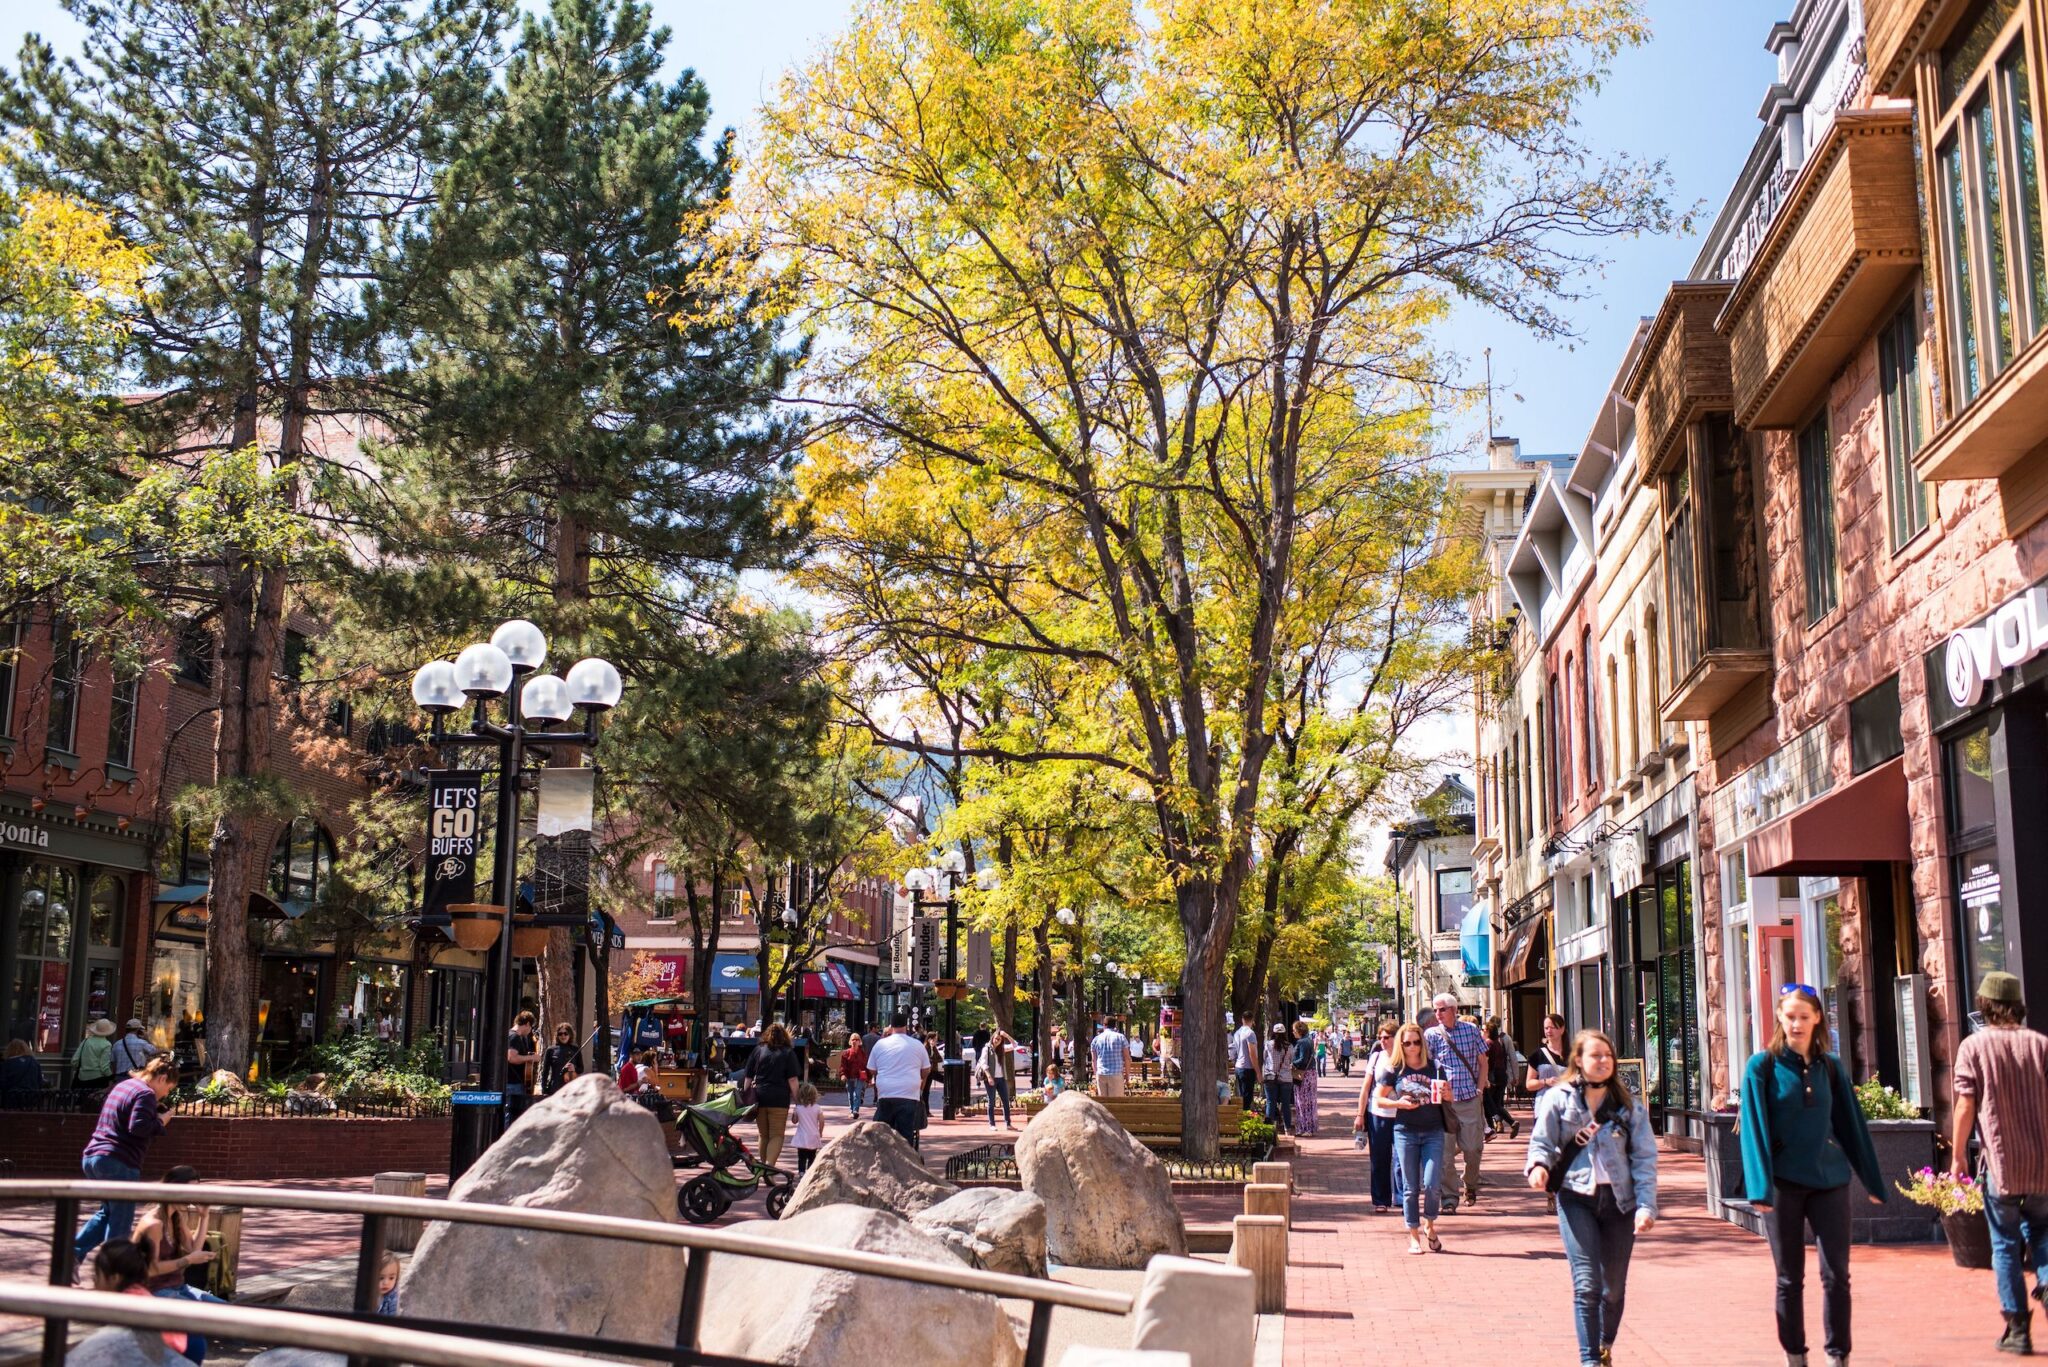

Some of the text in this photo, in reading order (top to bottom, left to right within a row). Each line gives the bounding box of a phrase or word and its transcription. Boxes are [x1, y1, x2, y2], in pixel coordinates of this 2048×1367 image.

[434, 787, 477, 808] LET'S
[433, 807, 475, 838] GO
[431, 837, 473, 856] BUFFS
[762, 890, 786, 904] BFFS
[919, 921, 931, 982] Be Boulder.
[893, 963, 900, 974] Be
